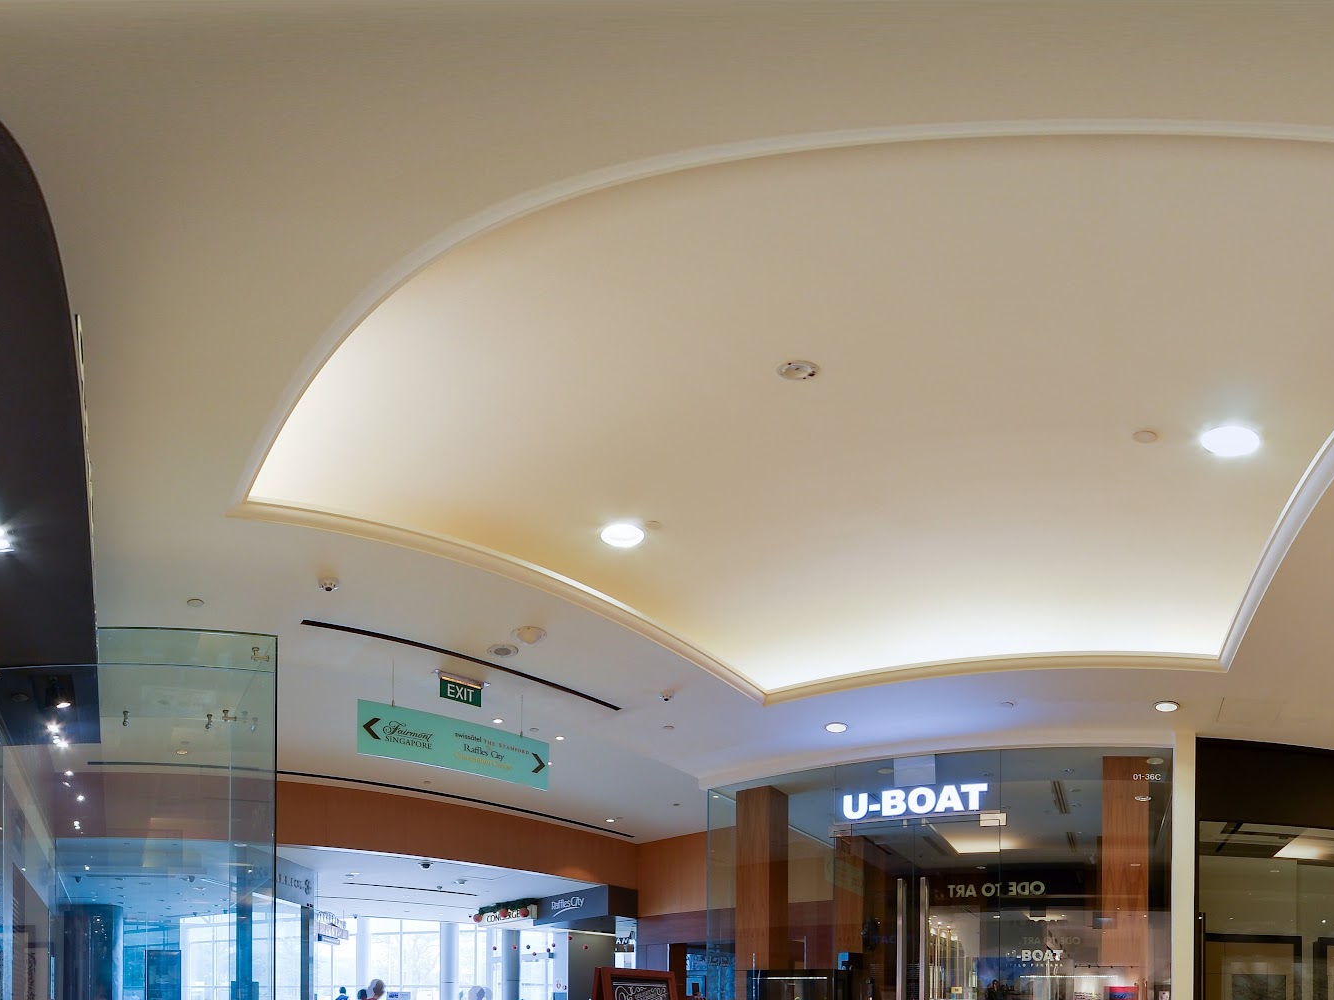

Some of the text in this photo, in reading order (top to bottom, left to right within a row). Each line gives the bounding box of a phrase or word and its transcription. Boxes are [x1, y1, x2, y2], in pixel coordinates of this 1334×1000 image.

[447, 684, 475, 702] EXIT
[382, 720, 433, 742] Fairmont
[384, 735, 433, 750] SINGAPORE
[454, 732, 530, 755] swissôtel THE STAMFORD
[463, 743, 505, 762] Raffles City
[1132, 773, 1162, 781] 01-36C
[842, 782, 989, 820] U-BOAT
